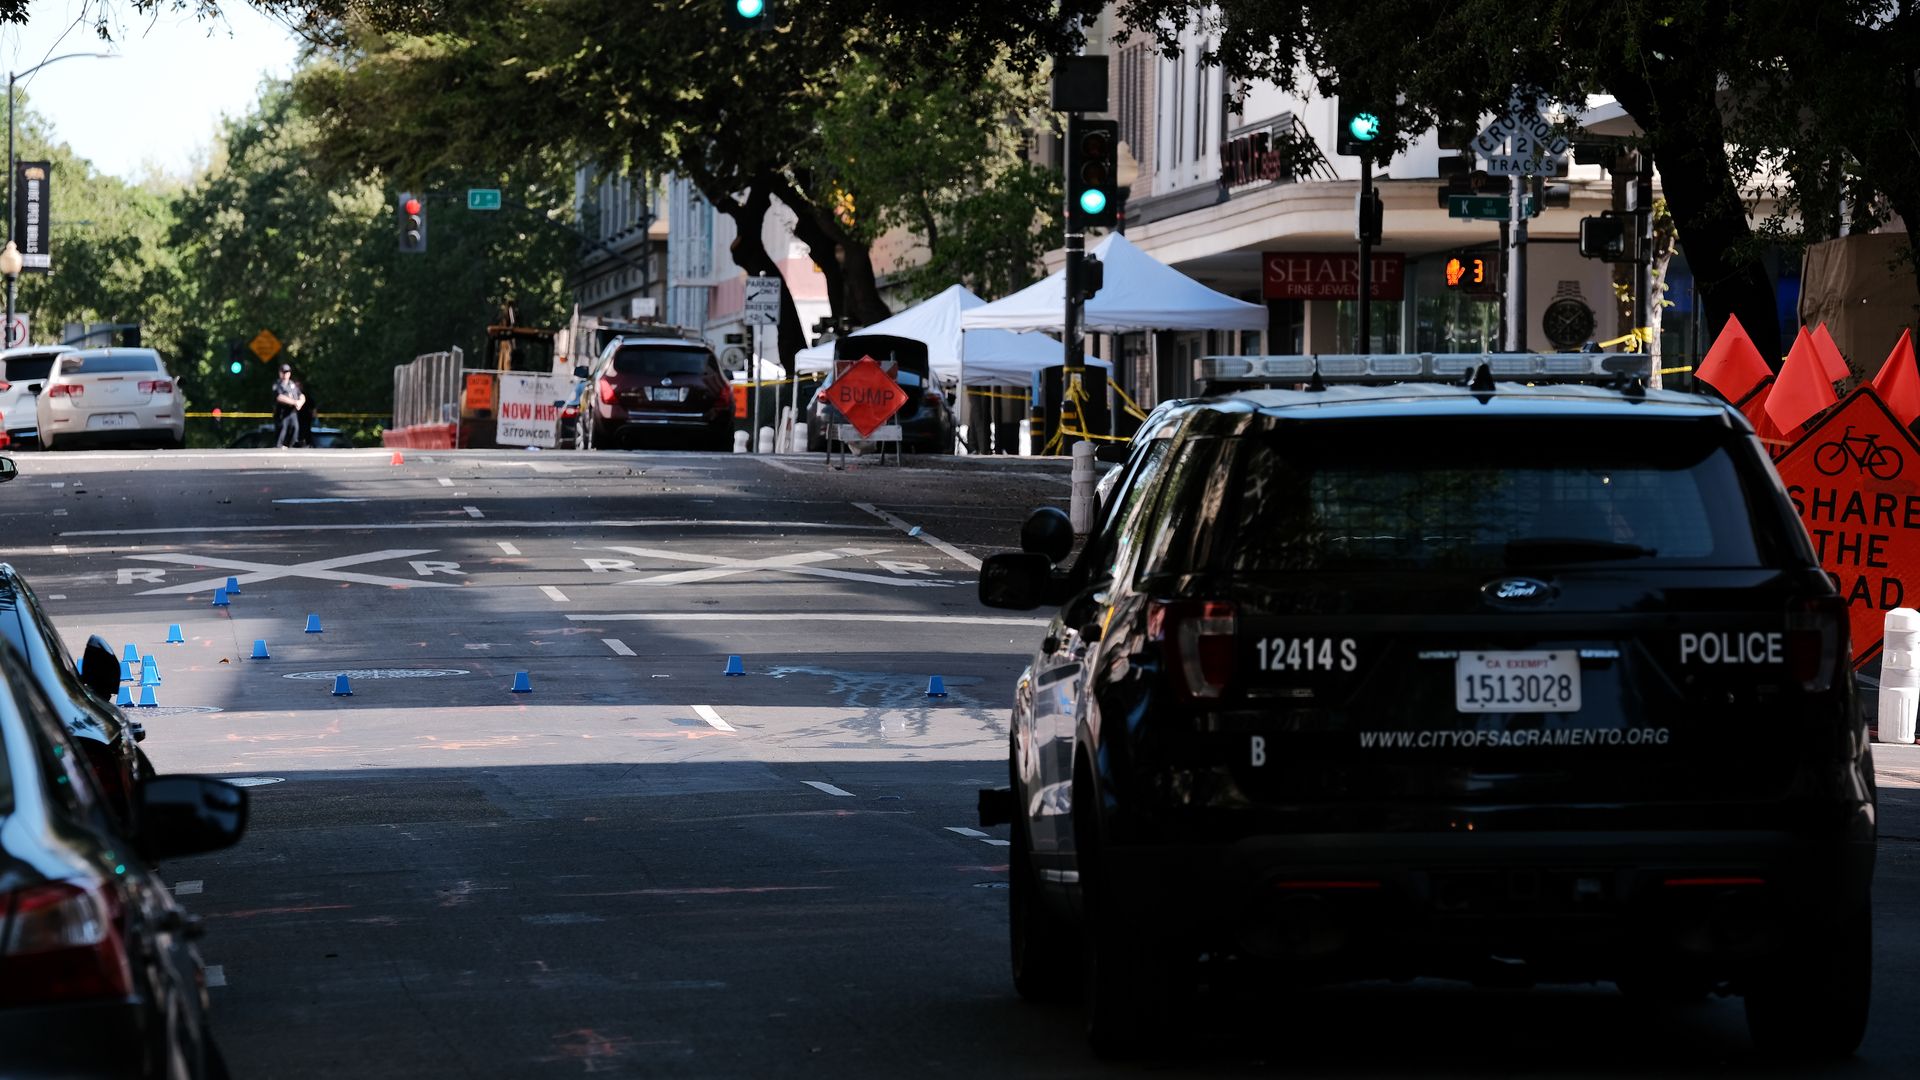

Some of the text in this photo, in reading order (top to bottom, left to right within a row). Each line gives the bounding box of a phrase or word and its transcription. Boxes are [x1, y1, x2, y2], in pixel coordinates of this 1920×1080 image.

[1517, 137, 1527, 153] 2
[1490, 159, 1553, 171] TRACKS
[473, 193, 480, 205] J
[1461, 200, 1469, 214] K
[1269, 258, 1398, 283] SHARIF
[1473, 259, 1483, 283] 3
[746, 280, 779, 288] PARKING
[1287, 283, 1379, 297] FINE JEWELS
[840, 386, 895, 406] BUMP
[502, 402, 531, 420] NOW
[1787, 485, 1920, 529] SHARE
[1813, 529, 1889, 568] THE
[1496, 581, 1537, 599] Ford
[1256, 637, 1358, 671] 12414 S
[1680, 631, 1785, 665] POLICE
[1486, 659, 1549, 669] CA EXEMPT
[1465, 674, 1572, 703] 1513028
[1359, 727, 1670, 749] WWW.CITYOFSACRAMENTO.ORG
[1250, 734, 1267, 768] B
